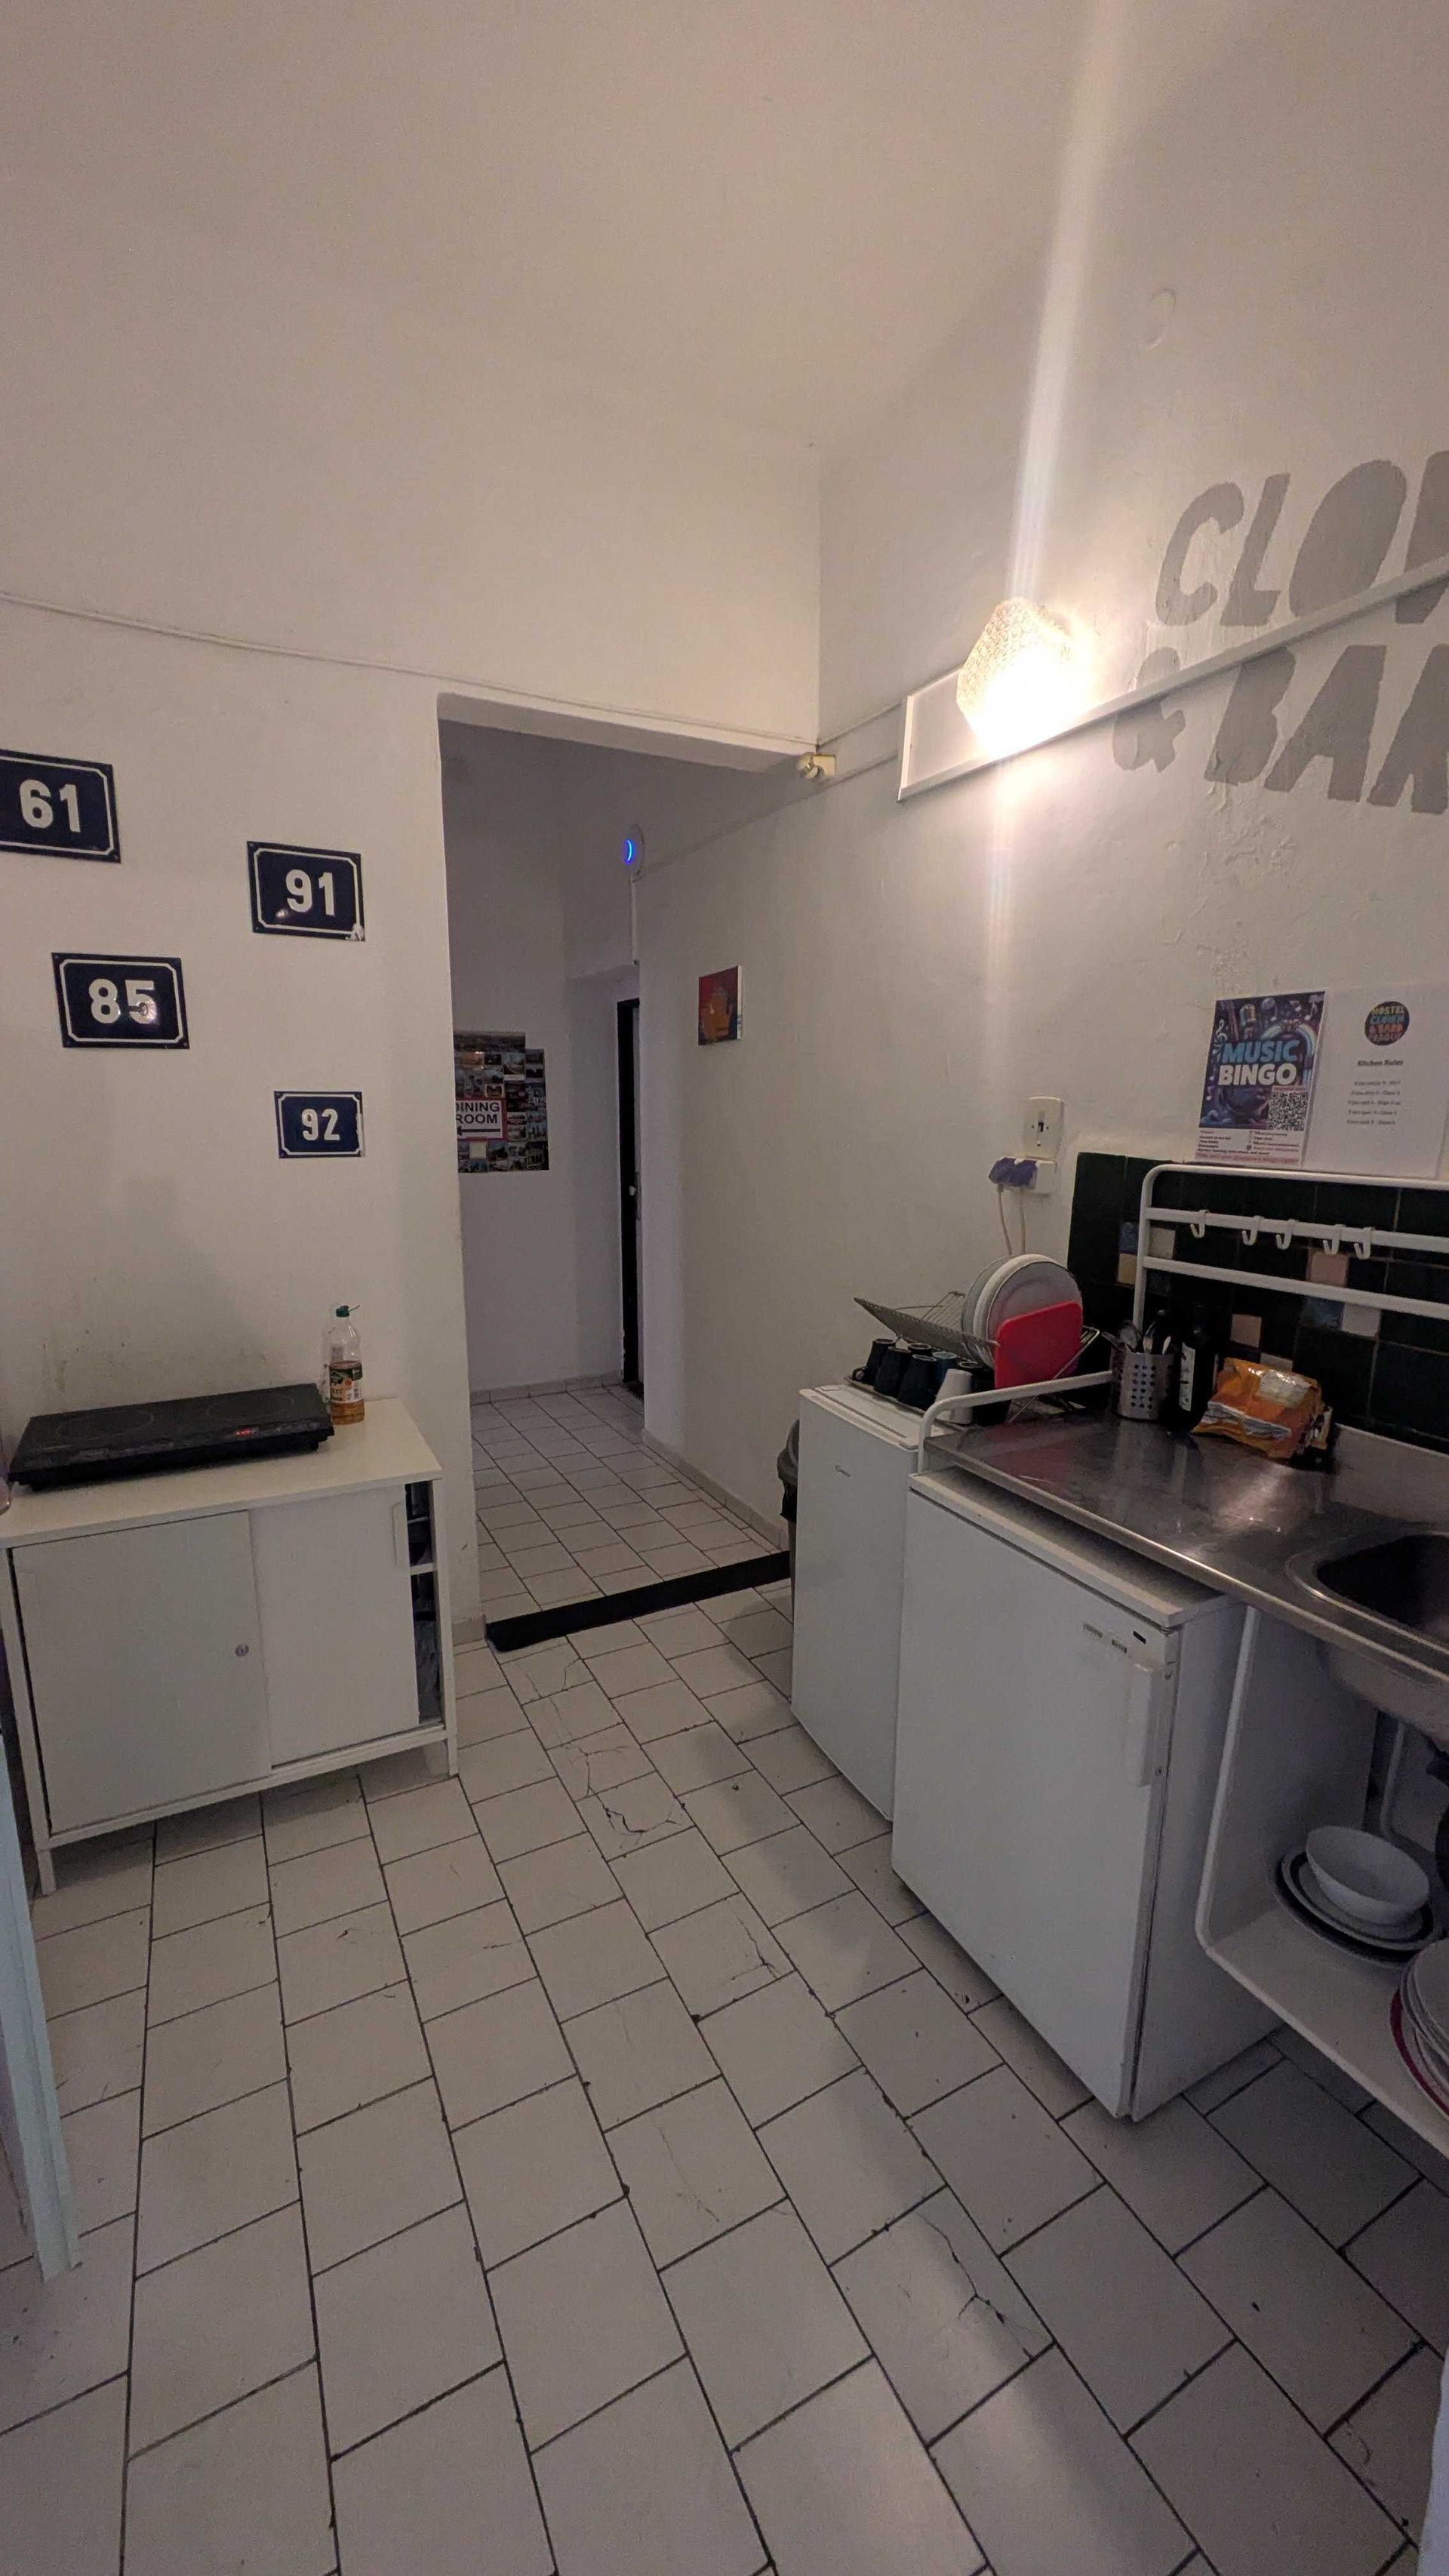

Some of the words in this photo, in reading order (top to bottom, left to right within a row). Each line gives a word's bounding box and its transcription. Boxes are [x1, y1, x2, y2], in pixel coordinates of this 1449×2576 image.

[19, 779, 81, 833] 61
[285, 869, 334, 916] 91
[88, 979, 155, 1024] 85
[1223, 1040, 1299, 1063] MUSIC
[1219, 1063, 1297, 1085] BINGO
[301, 1109, 340, 1140] 92
